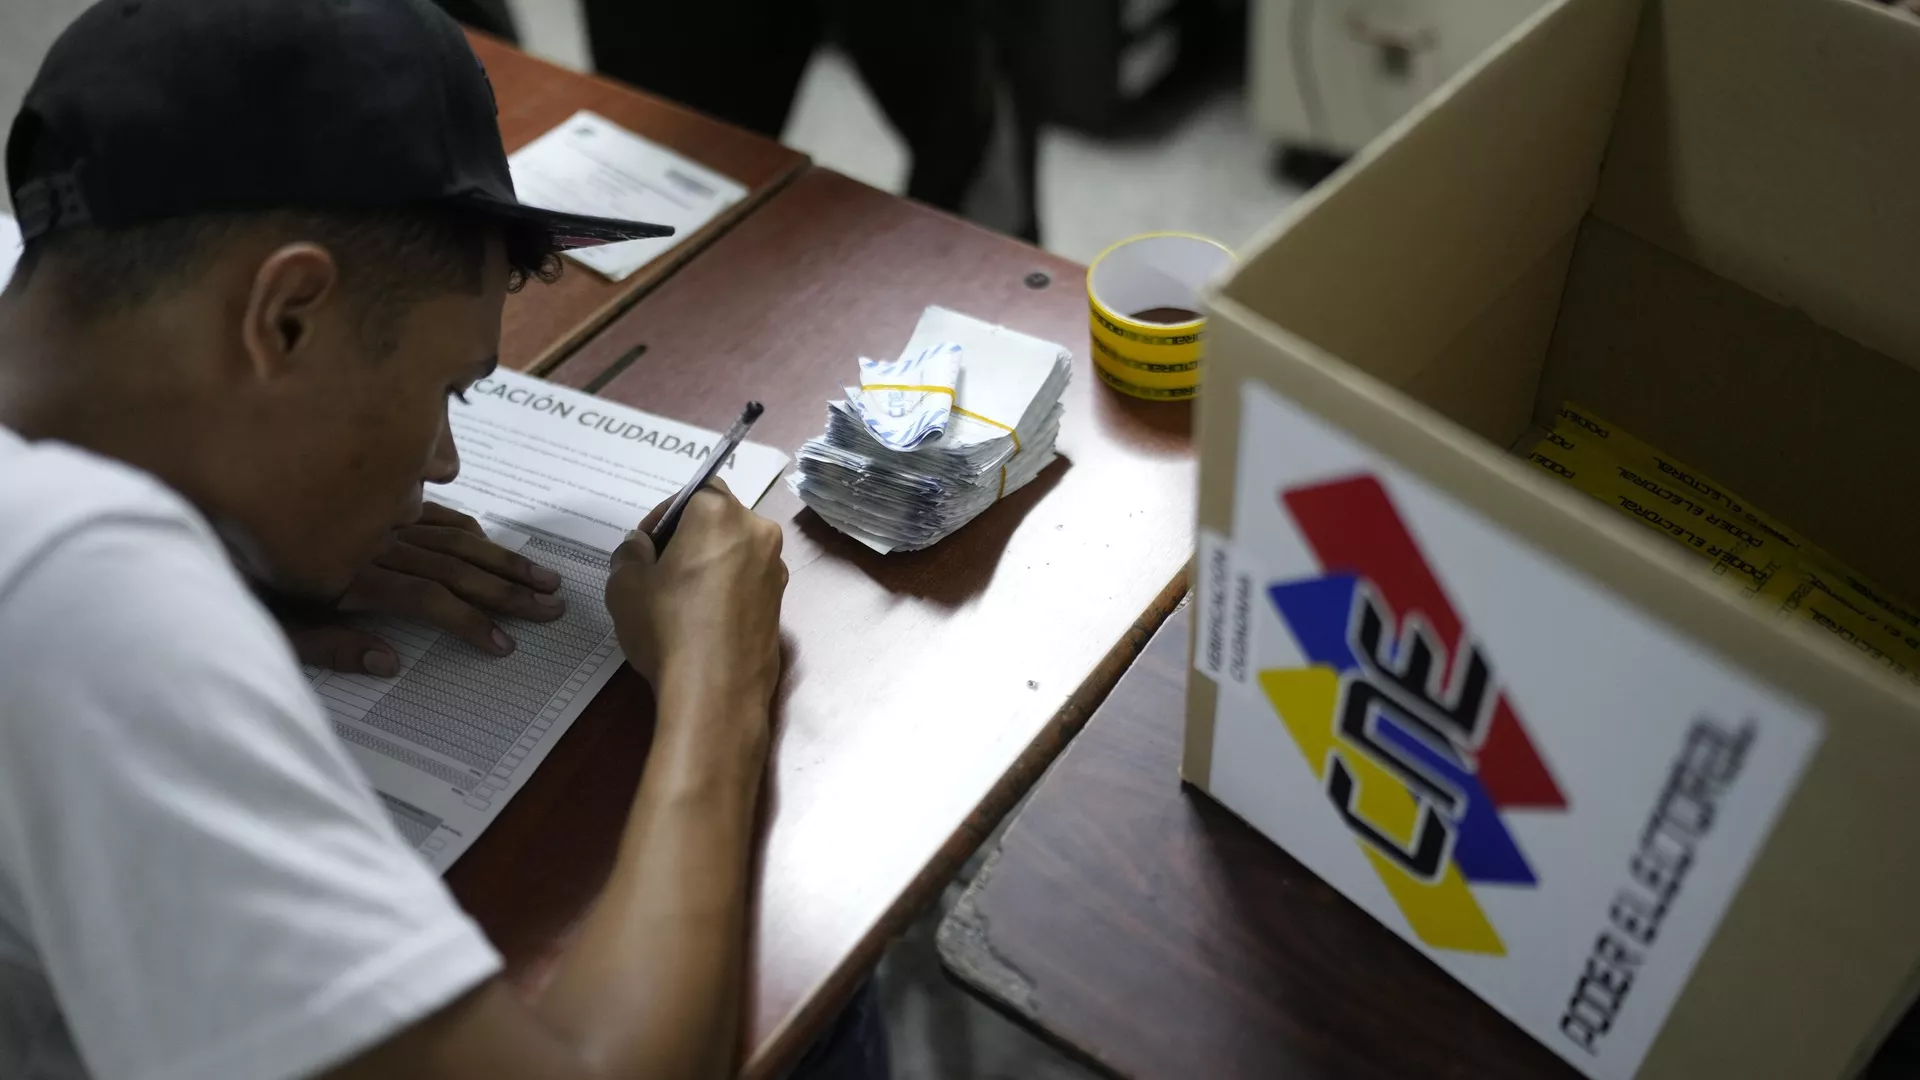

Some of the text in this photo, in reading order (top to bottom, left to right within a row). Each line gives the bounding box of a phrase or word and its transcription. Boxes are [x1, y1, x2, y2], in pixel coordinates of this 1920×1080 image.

[1705, 513, 1765, 548] PODER
[1706, 545, 1768, 581] PODER
[1557, 930, 1648, 1058] PODER
